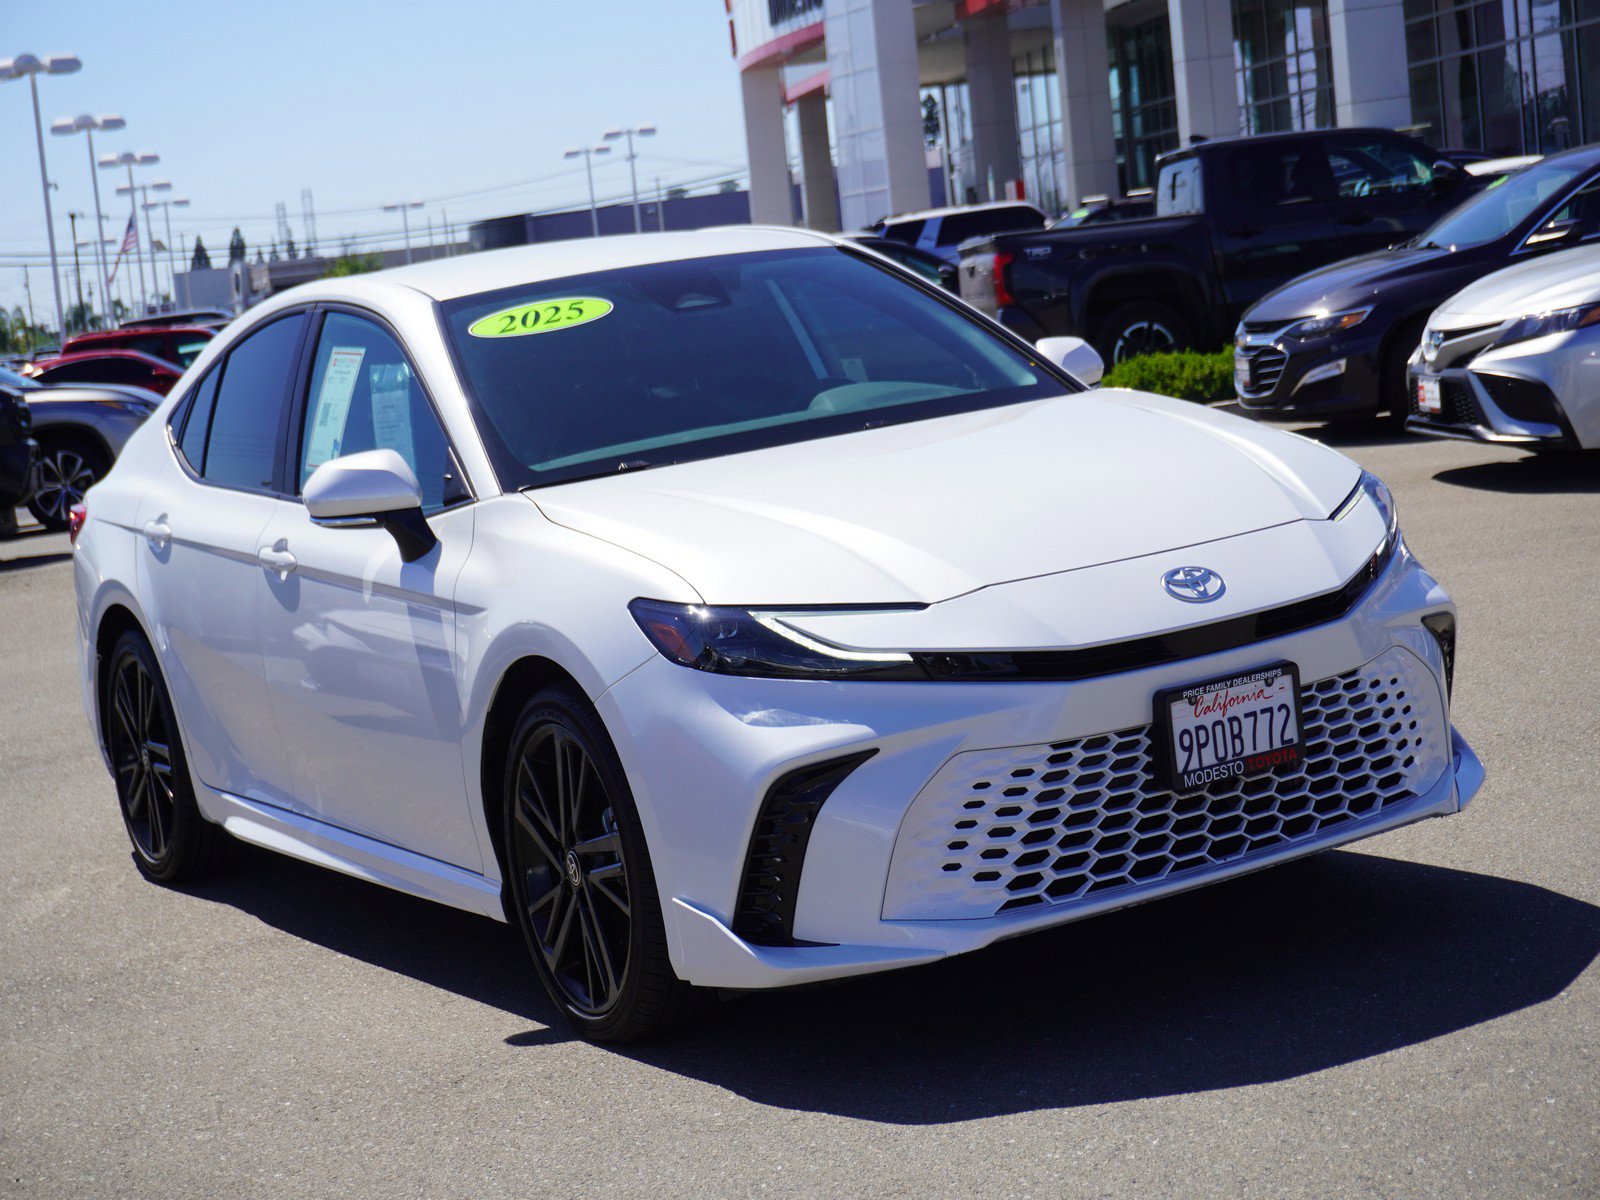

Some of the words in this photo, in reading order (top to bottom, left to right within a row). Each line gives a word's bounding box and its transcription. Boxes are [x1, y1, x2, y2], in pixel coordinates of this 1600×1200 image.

[497, 300, 585, 335] 2025
[1182, 687, 1205, 699] PRICE
[1205, 680, 1232, 693] FAMILY
[1232, 668, 1282, 686] DEALERSHIPS
[1193, 686, 1274, 719] California
[1183, 760, 1244, 788] MODESTO
[1247, 748, 1297, 770] TOYOTA
